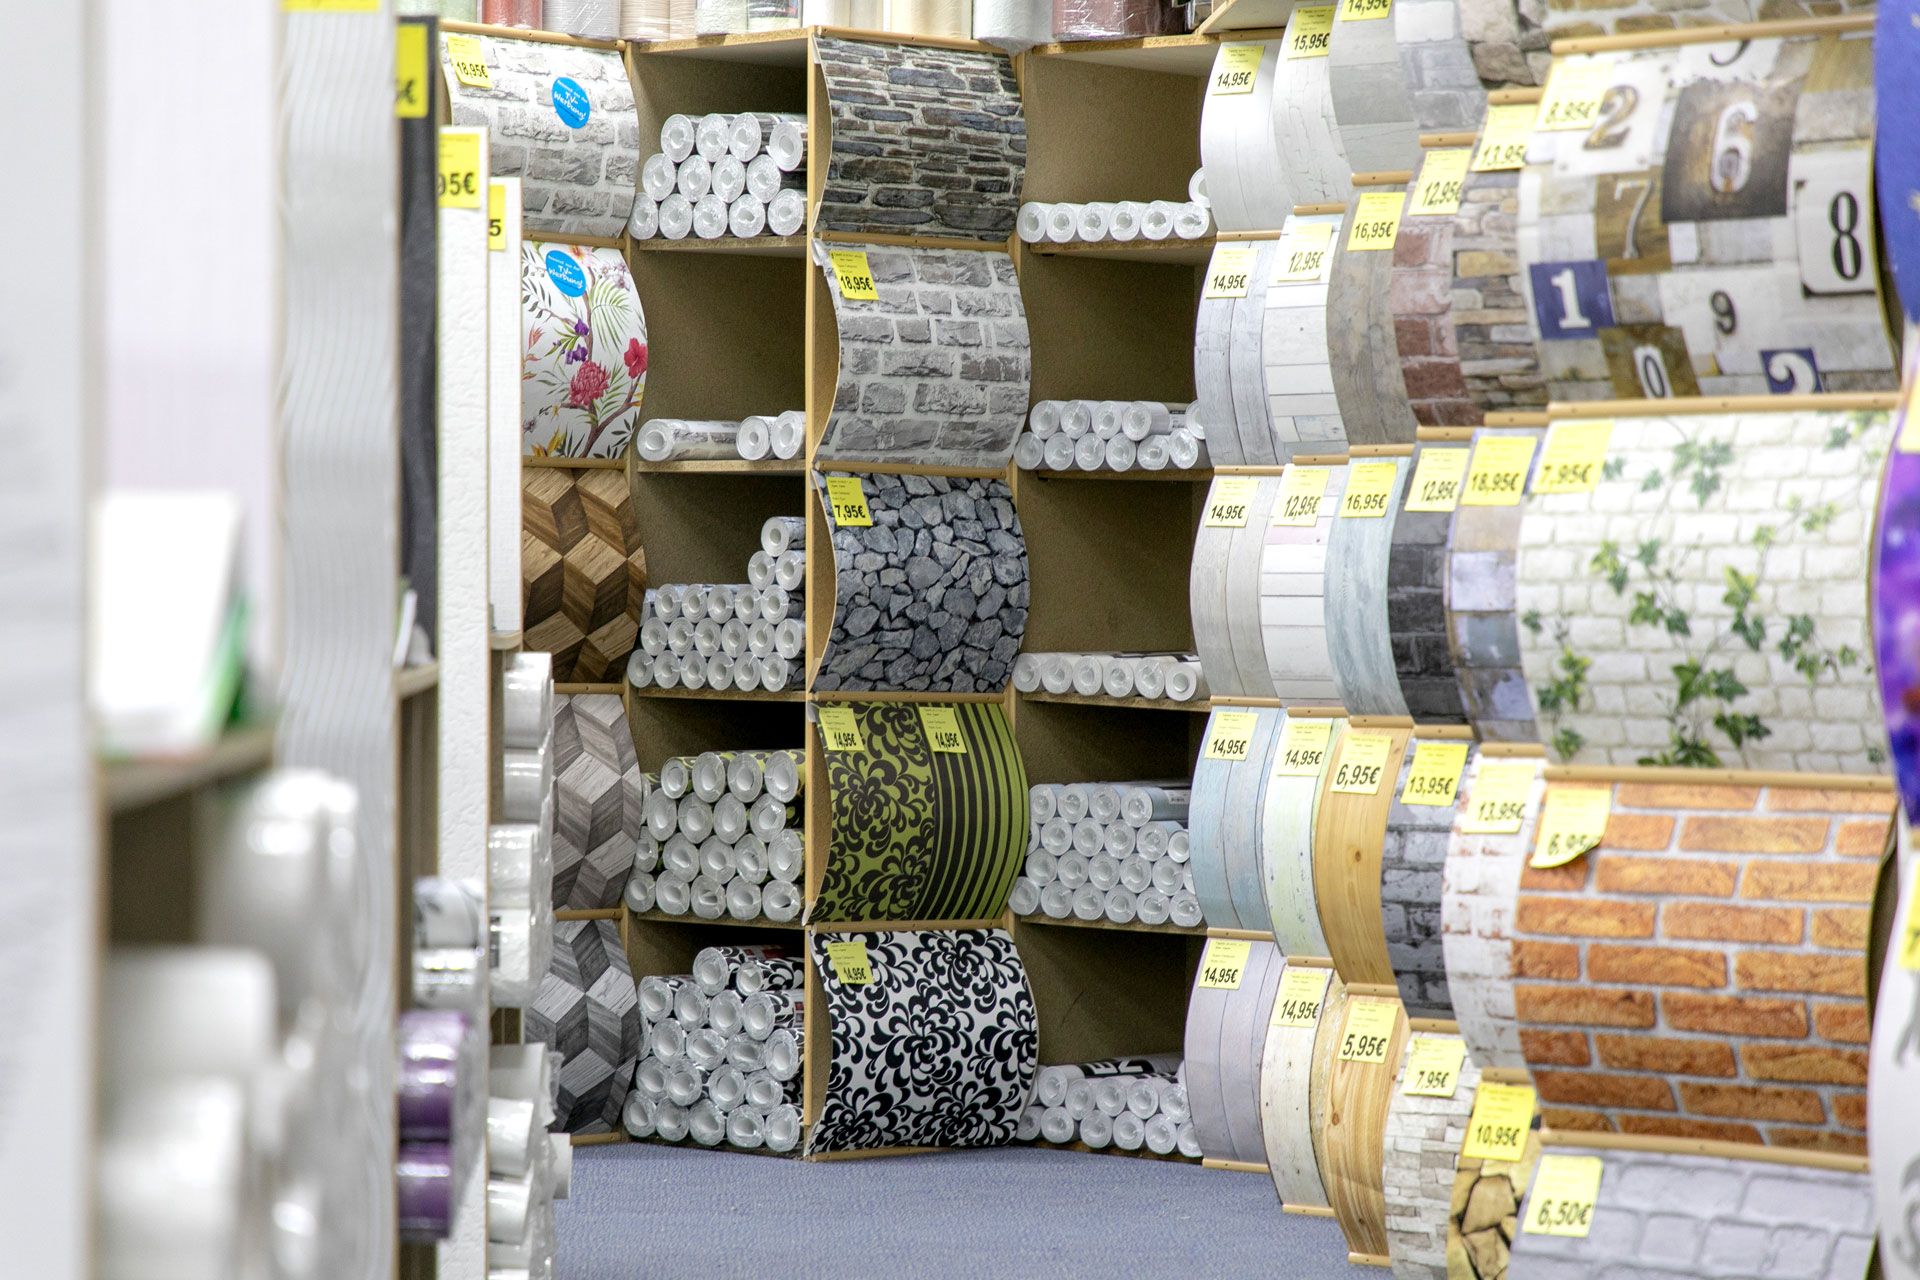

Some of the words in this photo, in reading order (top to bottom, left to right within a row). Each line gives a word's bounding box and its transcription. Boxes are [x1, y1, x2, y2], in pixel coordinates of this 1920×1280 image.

[1294, 33, 1330, 52] 15,95€
[1217, 72, 1251, 88] 14,95€
[1710, 101, 1759, 194] 6
[1354, 221, 1394, 242] 16,95€
[1829, 191, 1863, 281] 8
[1288, 251, 1324, 274] 12,95€
[840, 275, 873, 293] 18,95€
[1213, 274, 1247, 292] 14,95€
[1550, 268, 1592, 330] 1
[1710, 290, 1737, 335] 9
[1470, 473, 1520, 495] 18,95€
[834, 504, 866, 521] 7,95€
[1211, 505, 1245, 523] 14,95€
[1284, 495, 1321, 521] 12,95€
[1347, 494, 1387, 513] 16,95€
[1212, 738, 1247, 757] 14,95€
[1285, 749, 1323, 769] 14,95€
[1336, 764, 1381, 790] 6,95€
[1409, 776, 1454, 798] 13,95€
[1204, 966, 1239, 986] 14,95€
[1281, 999, 1320, 1024] 14,95€
[1343, 1034, 1387, 1060] 5,95€
[1414, 1070, 1450, 1091] 7,95€
[1475, 1123, 1521, 1149] 10,95€
[1537, 1198, 1592, 1234] 6,50€
